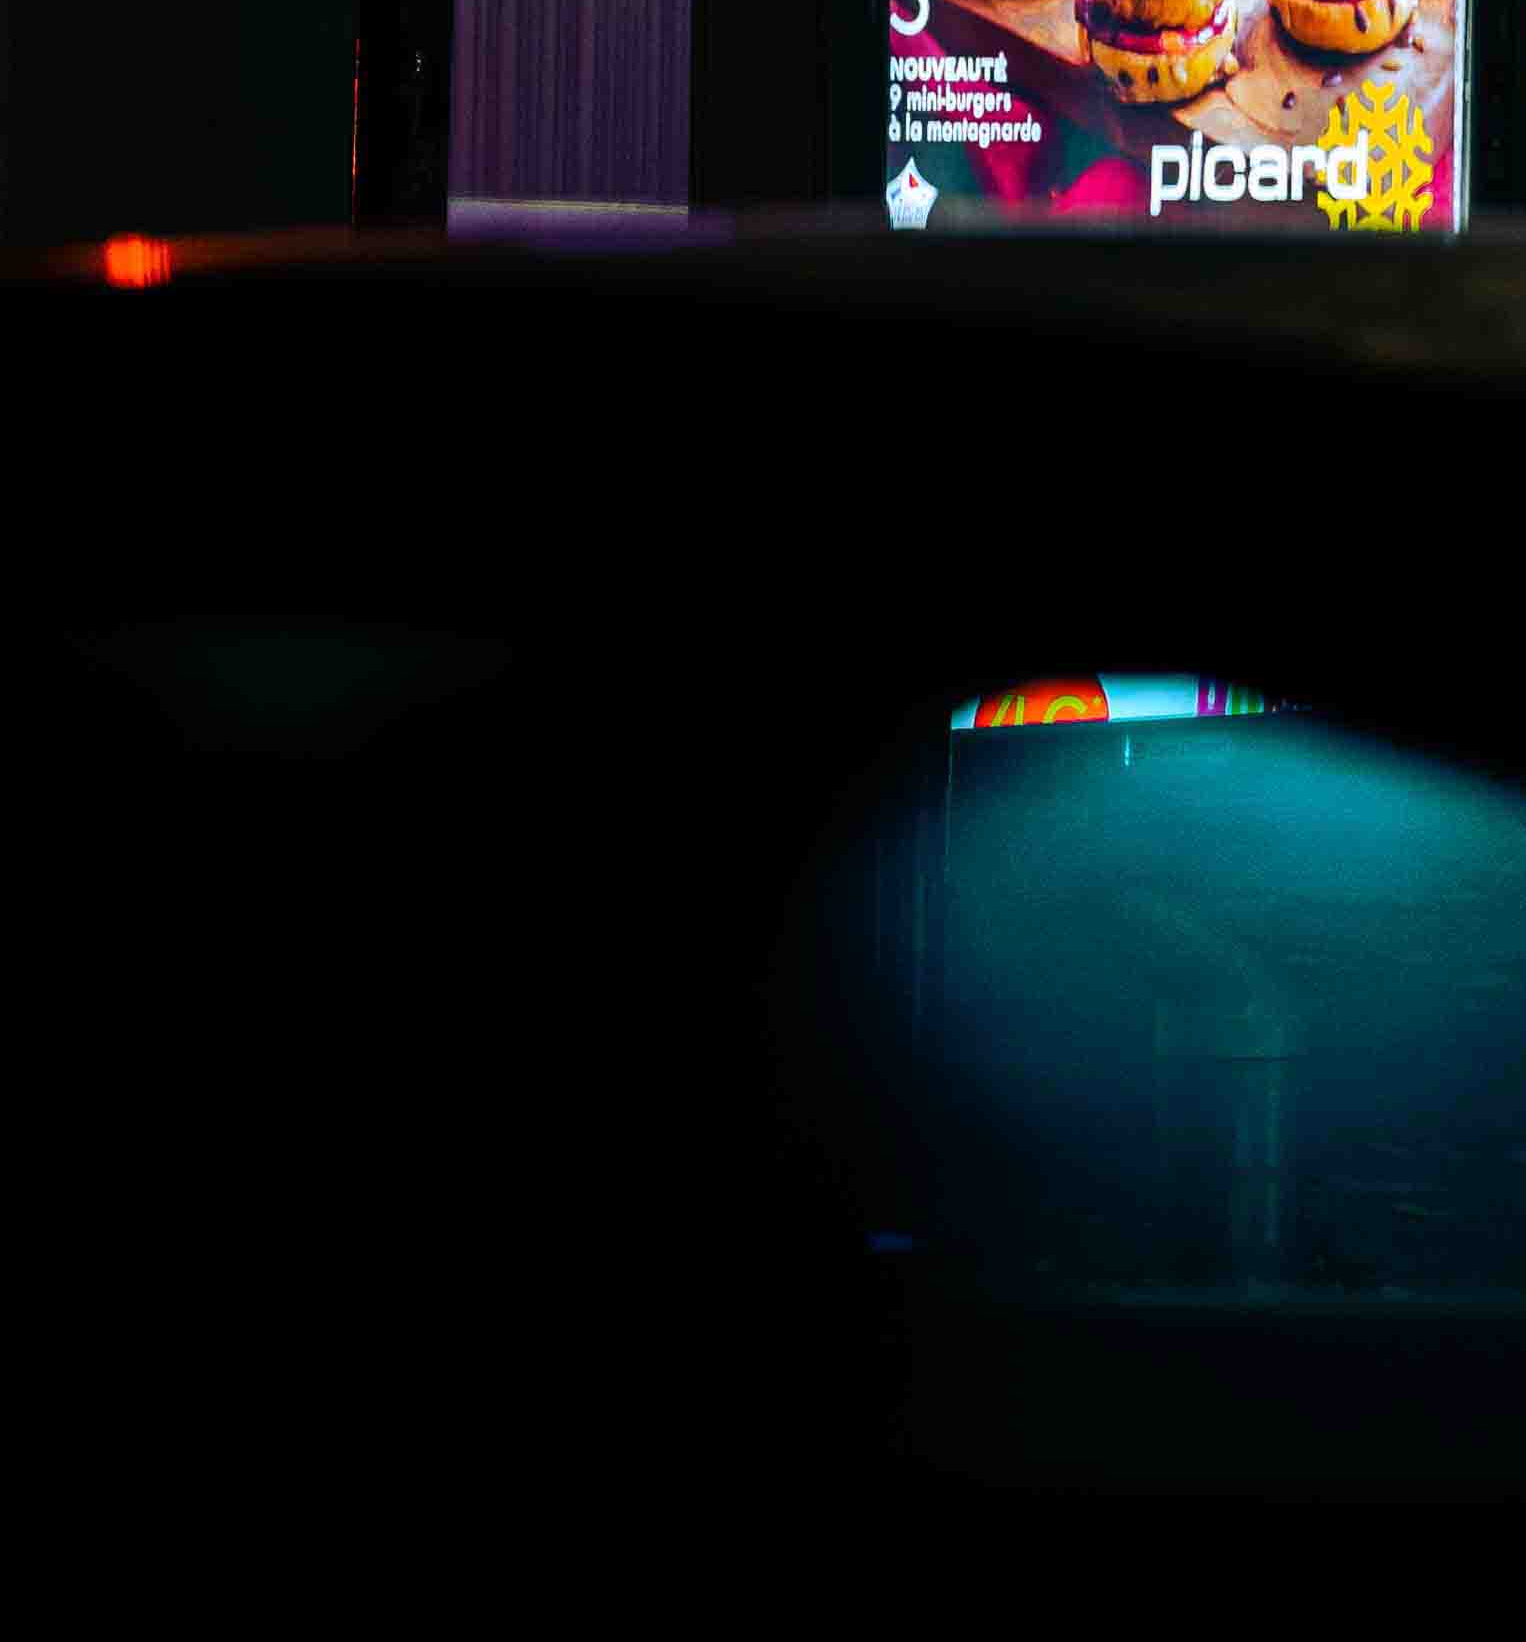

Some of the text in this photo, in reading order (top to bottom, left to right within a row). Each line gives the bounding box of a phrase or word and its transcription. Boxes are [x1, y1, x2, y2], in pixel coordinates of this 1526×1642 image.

[889, 51, 1008, 83] NOUVEAUTÉ
[889, 83, 1012, 118] 9 mini-burgers
[888, 113, 1042, 148] à la montagnarde
[1150, 129, 1370, 217] picard
